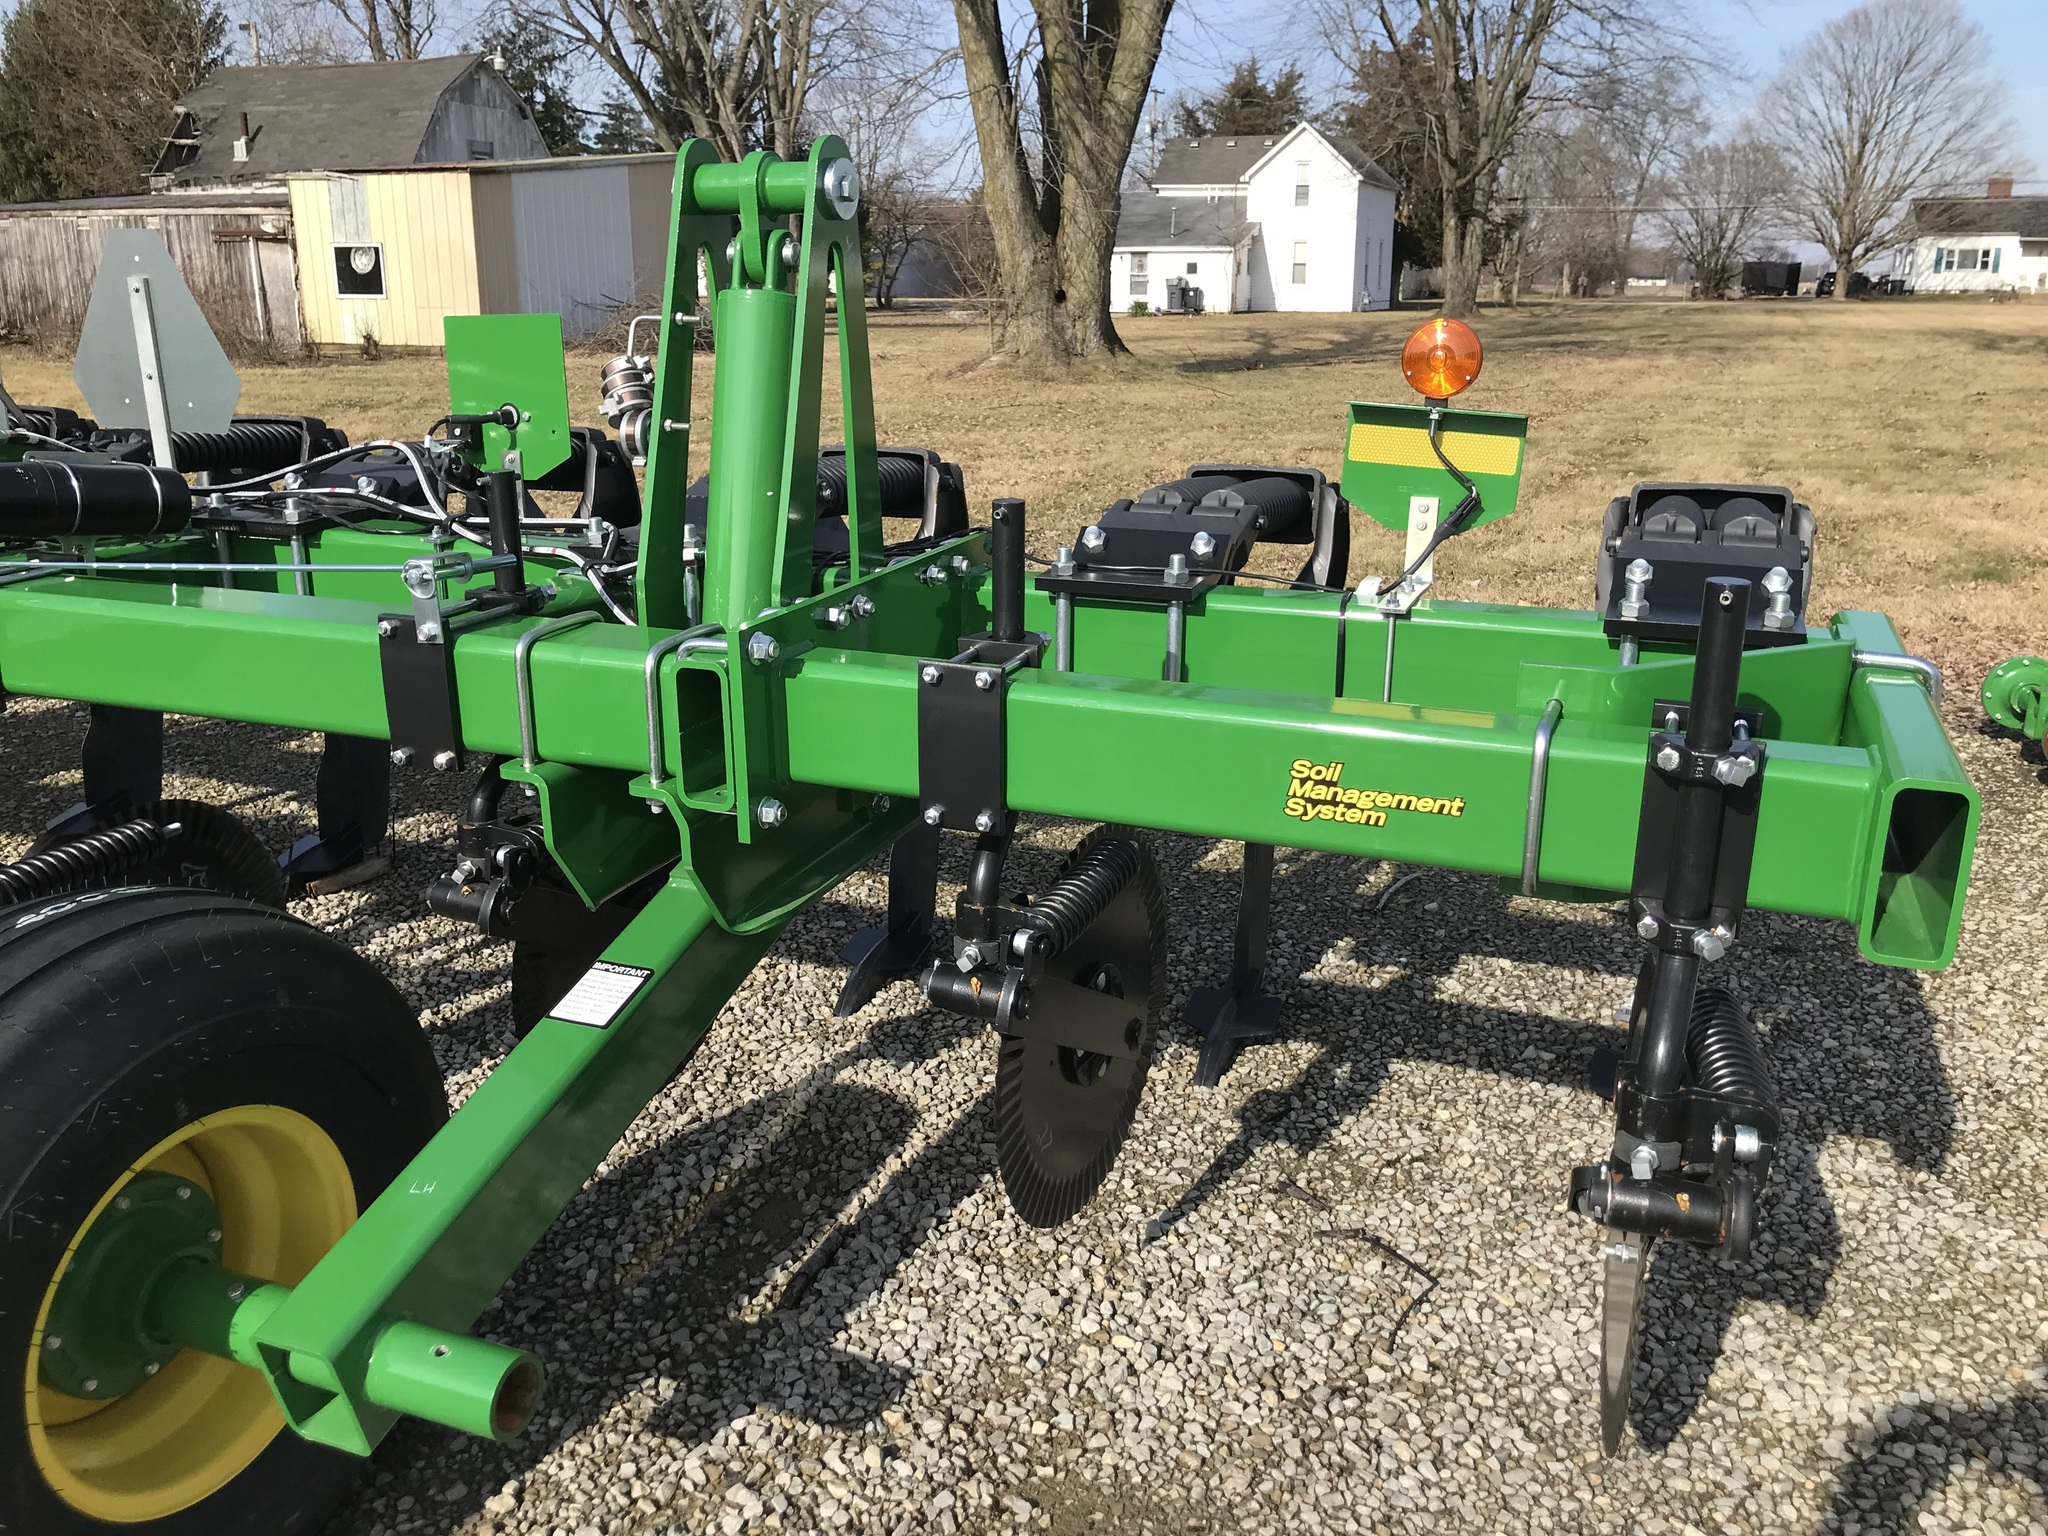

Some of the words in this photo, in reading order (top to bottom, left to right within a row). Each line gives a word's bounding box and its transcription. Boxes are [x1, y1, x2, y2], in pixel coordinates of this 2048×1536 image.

[1289, 758, 1344, 782] Soil
[1287, 778, 1466, 817] Management
[1283, 797, 1388, 827] System
[591, 961, 652, 978] IMPORTANT
[408, 1179, 437, 1194] LH
